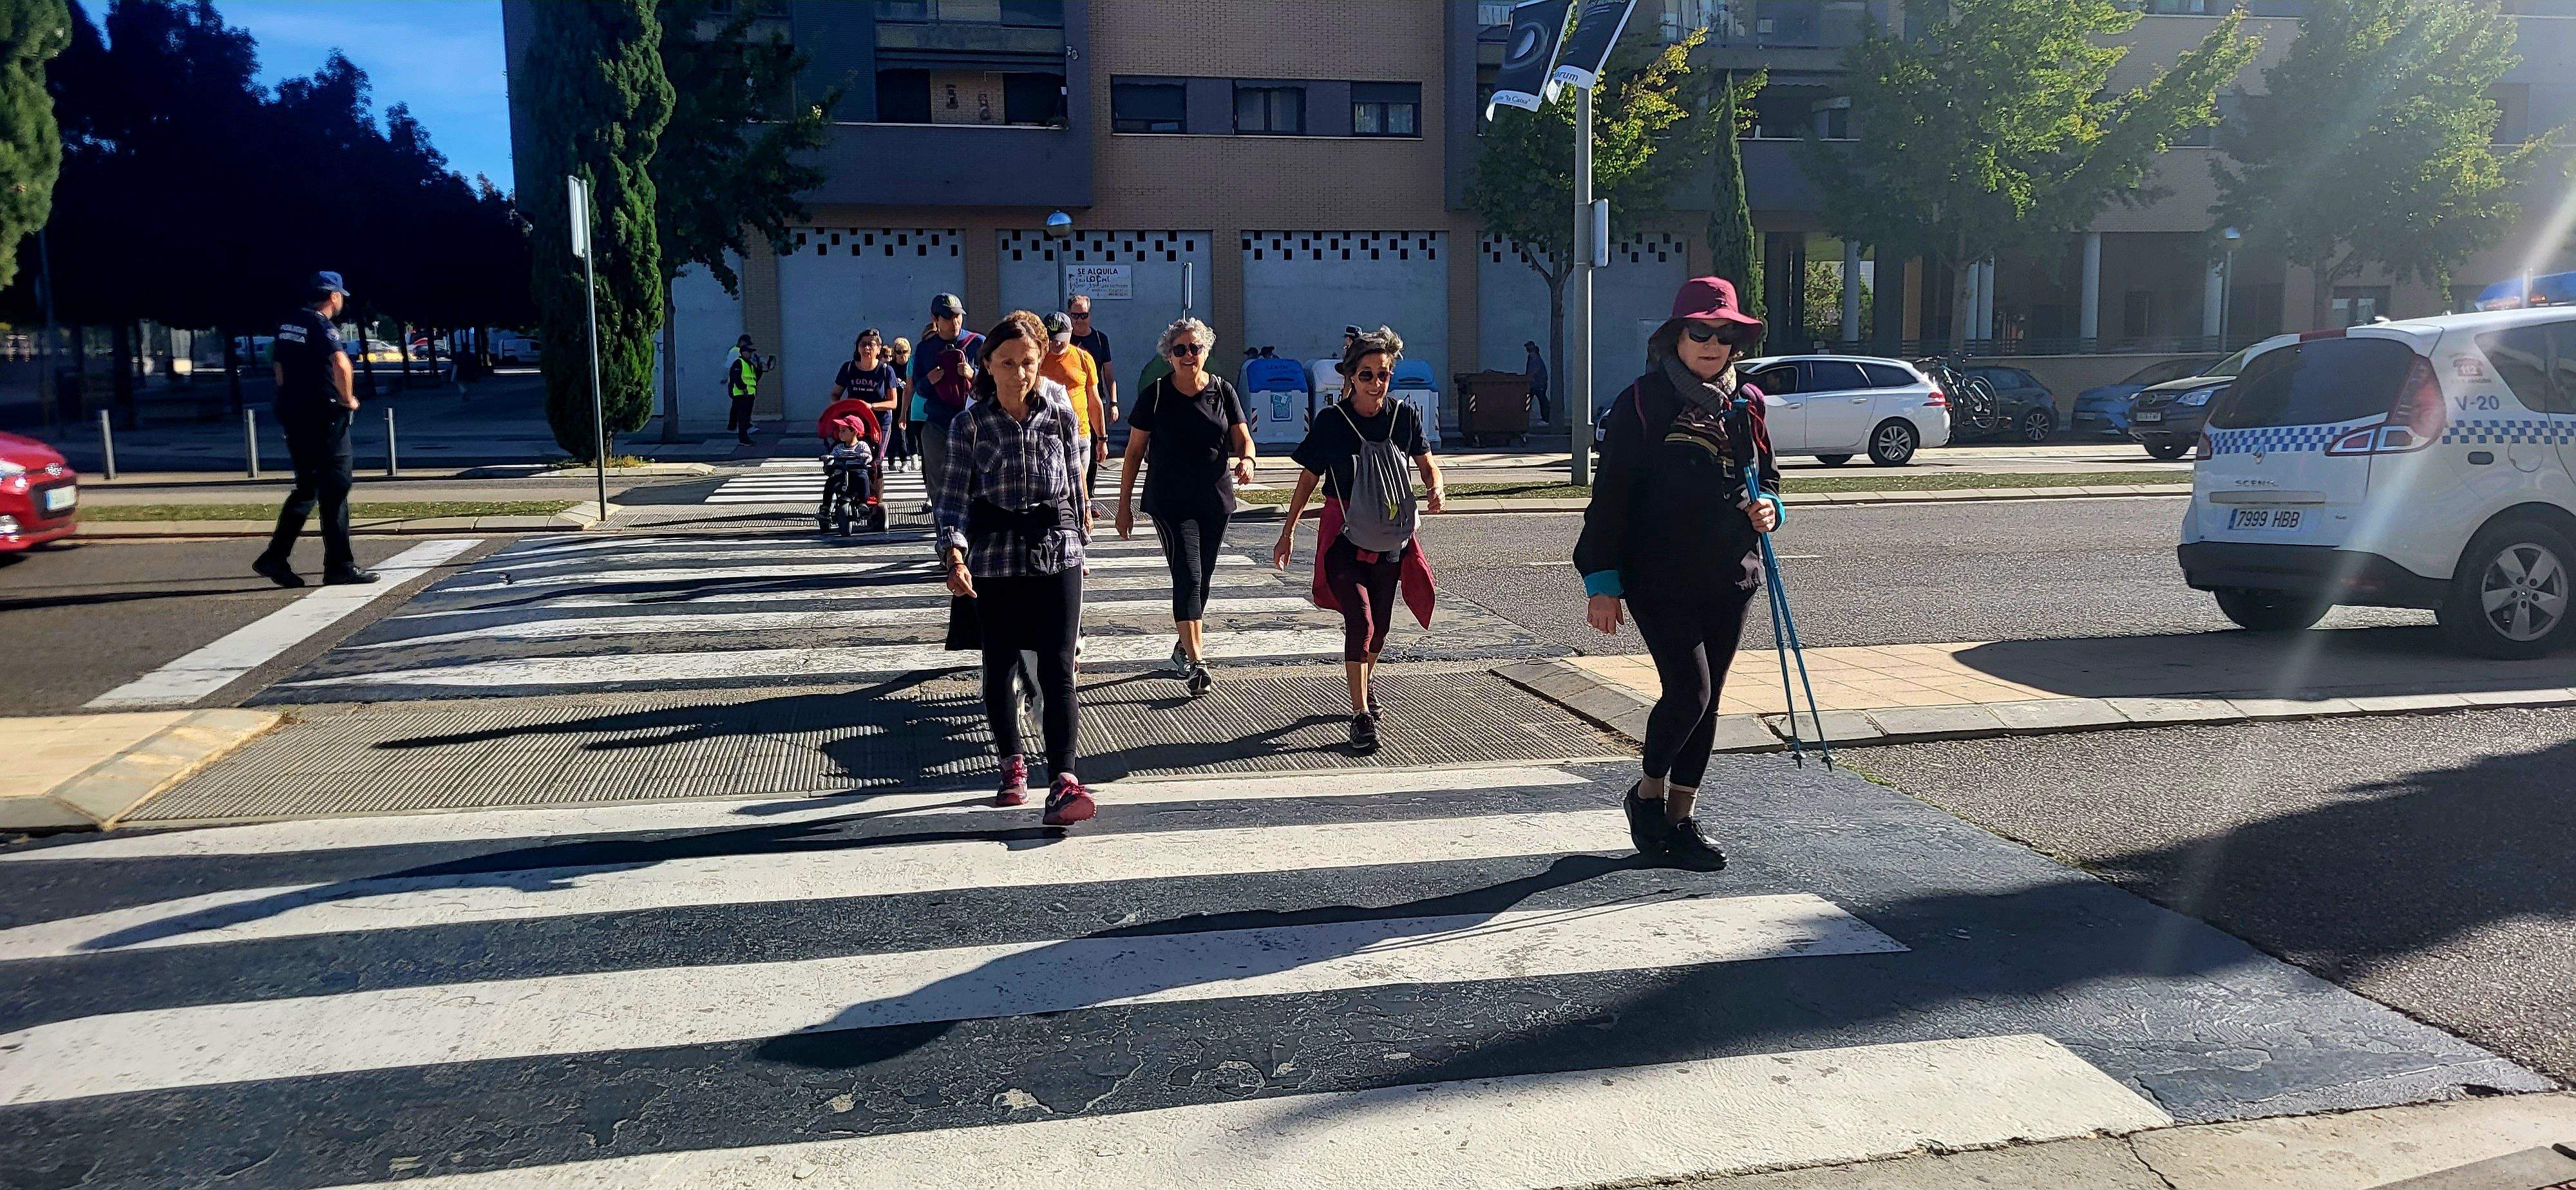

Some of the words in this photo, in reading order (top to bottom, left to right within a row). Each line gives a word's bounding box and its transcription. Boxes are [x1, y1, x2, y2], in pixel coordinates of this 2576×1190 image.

[2454, 395, 2500, 411] V-20
[2237, 511, 2269, 527] 7999
[2271, 510, 2301, 528] HBB
